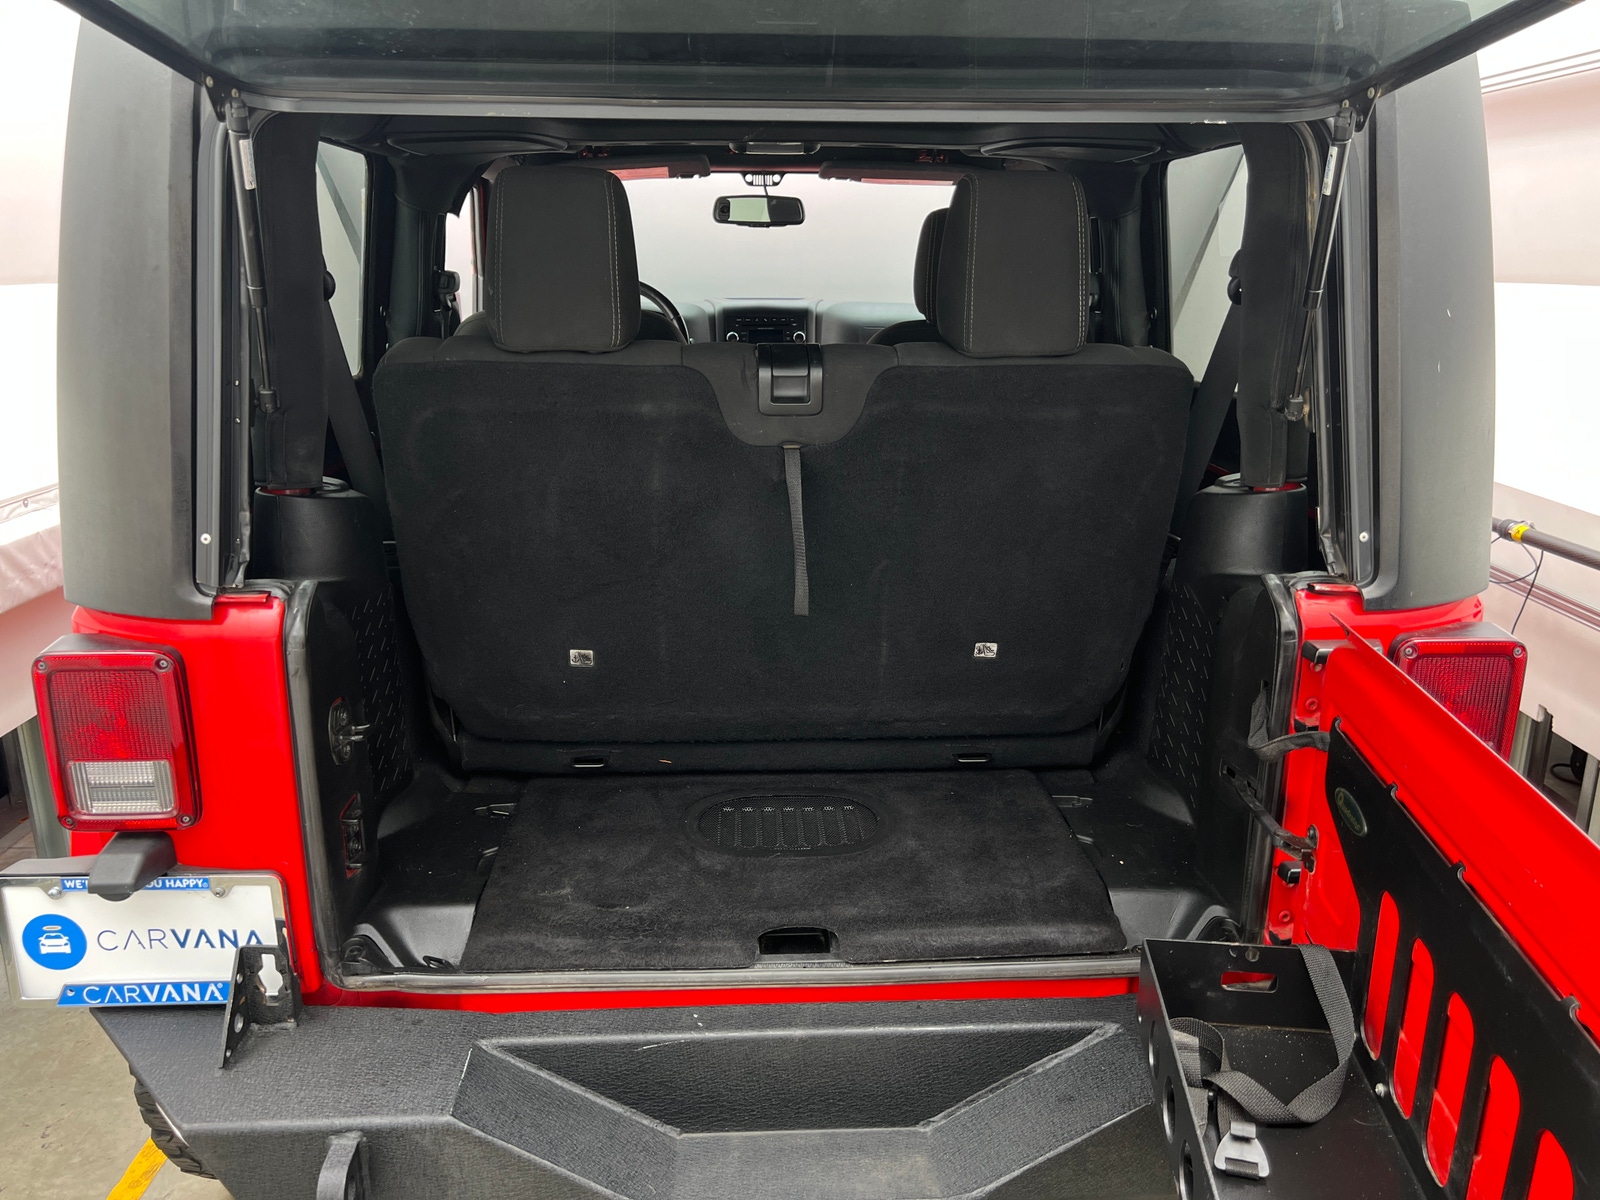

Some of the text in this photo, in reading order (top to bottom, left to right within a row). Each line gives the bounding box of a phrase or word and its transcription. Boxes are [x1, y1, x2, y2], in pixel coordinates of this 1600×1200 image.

[145, 879, 163, 888] OU
[165, 878, 204, 888] HAPPY
[97, 928, 263, 951] CARVANA
[83, 983, 224, 1004] CARVANA
